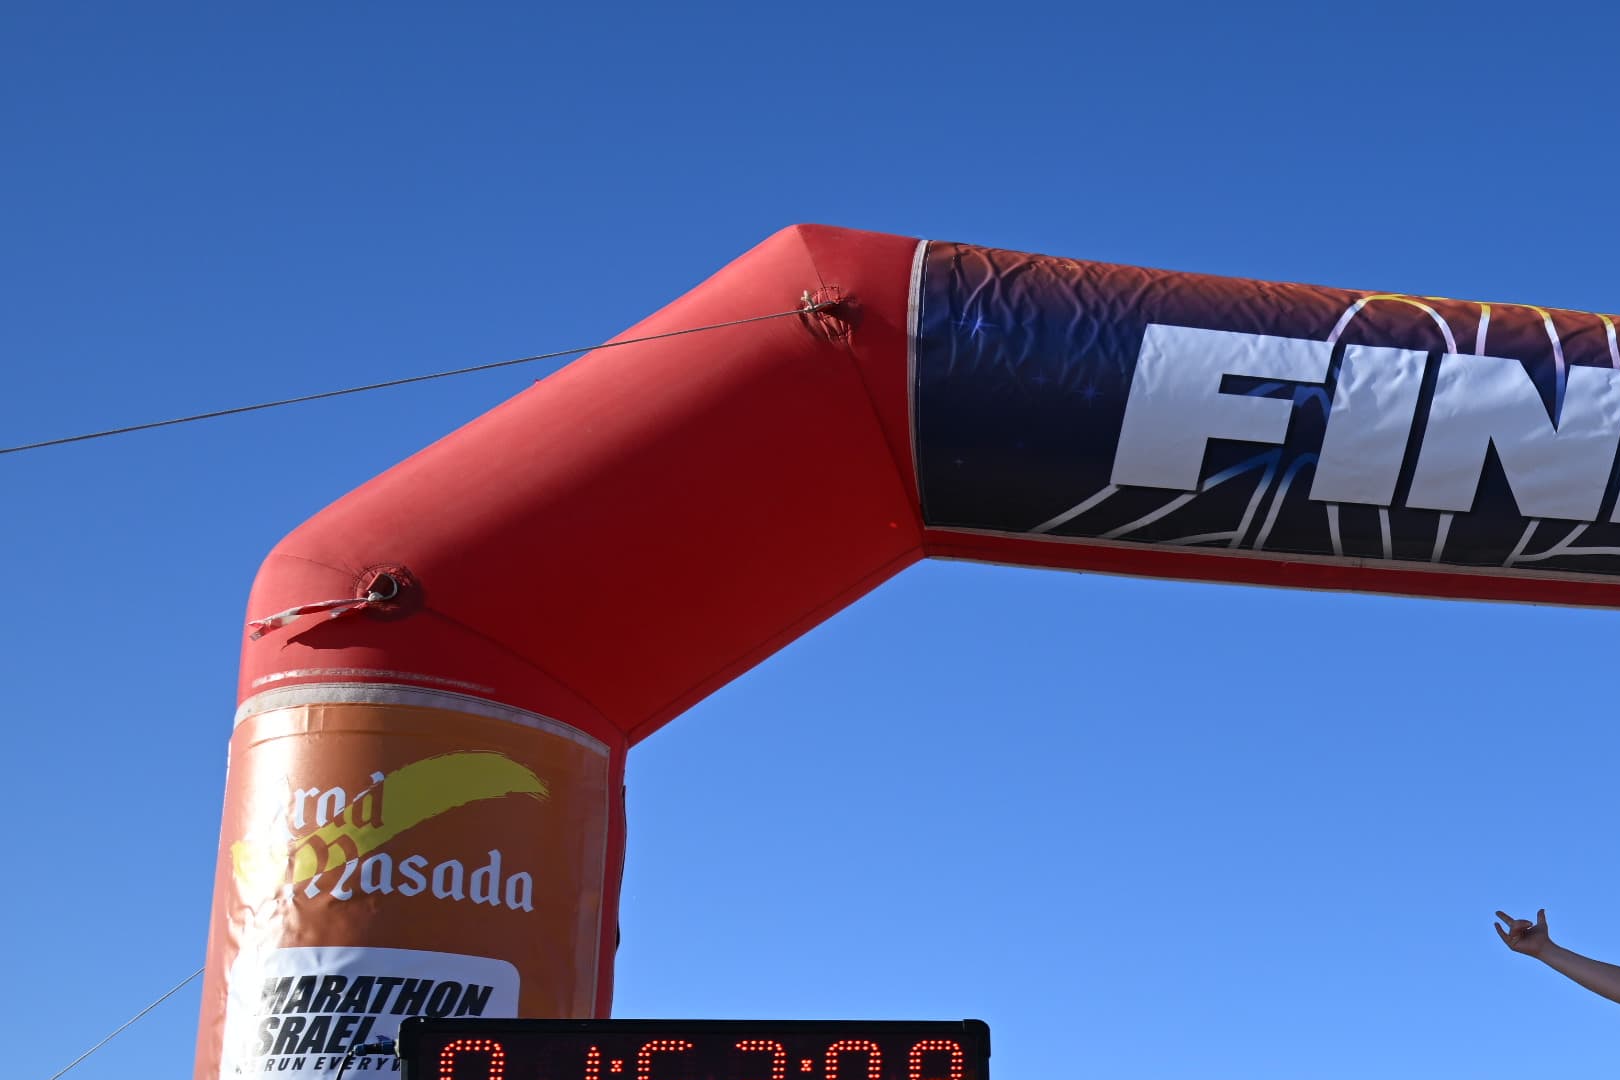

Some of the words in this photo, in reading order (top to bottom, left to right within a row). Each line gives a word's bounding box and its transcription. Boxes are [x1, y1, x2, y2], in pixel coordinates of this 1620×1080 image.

[268, 771, 385, 840] rad
[242, 1015, 377, 1056] SRAEL
[264, 1056, 307, 1072] RUN
